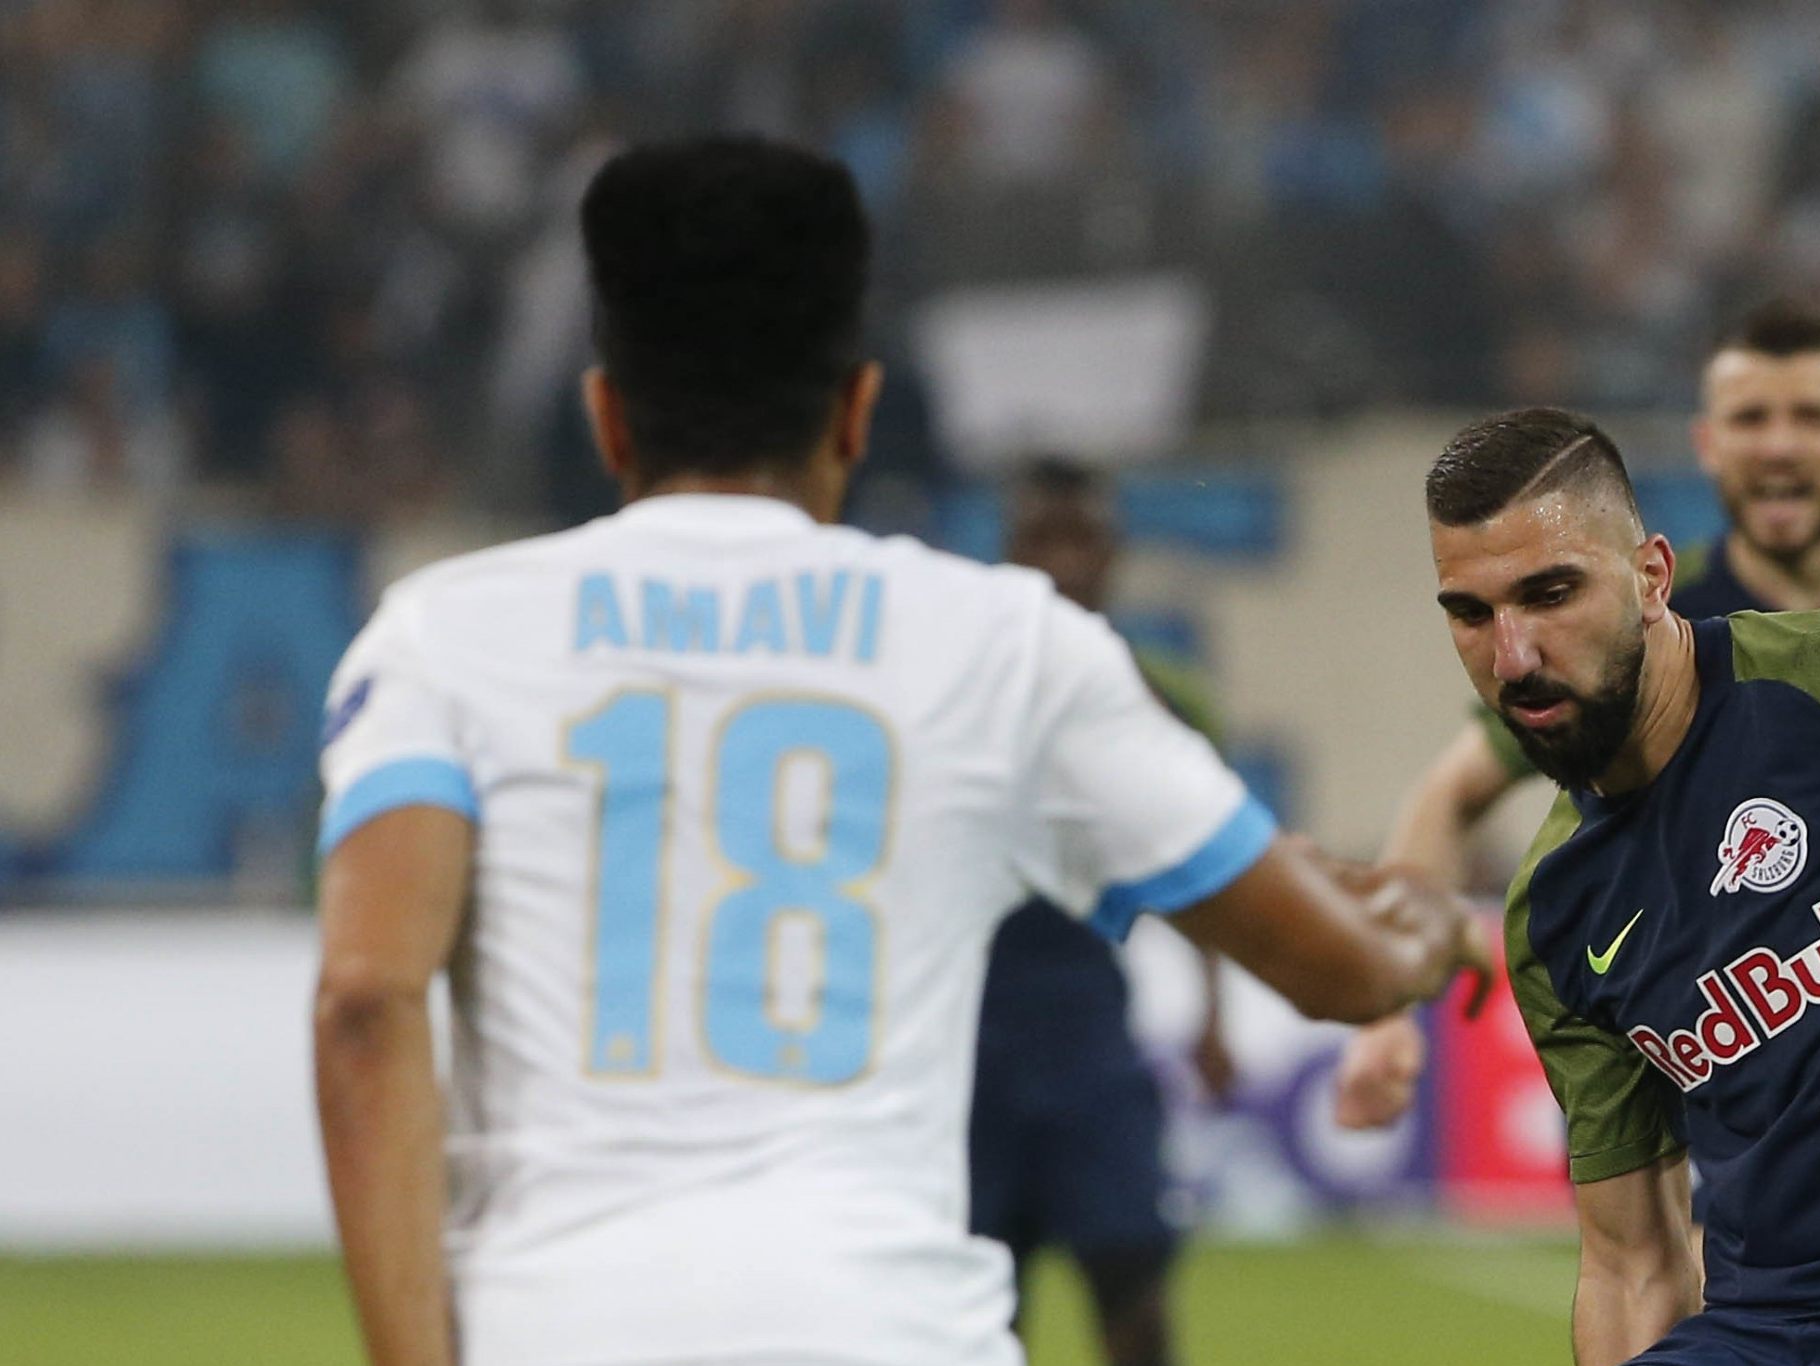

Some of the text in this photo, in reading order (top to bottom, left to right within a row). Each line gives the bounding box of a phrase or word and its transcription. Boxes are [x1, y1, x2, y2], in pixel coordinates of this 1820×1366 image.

[574, 570, 882, 662] AMAVI
[1741, 812, 1757, 828] FC
[560, 685, 897, 1087] 18
[1628, 972, 1758, 1091] Red
